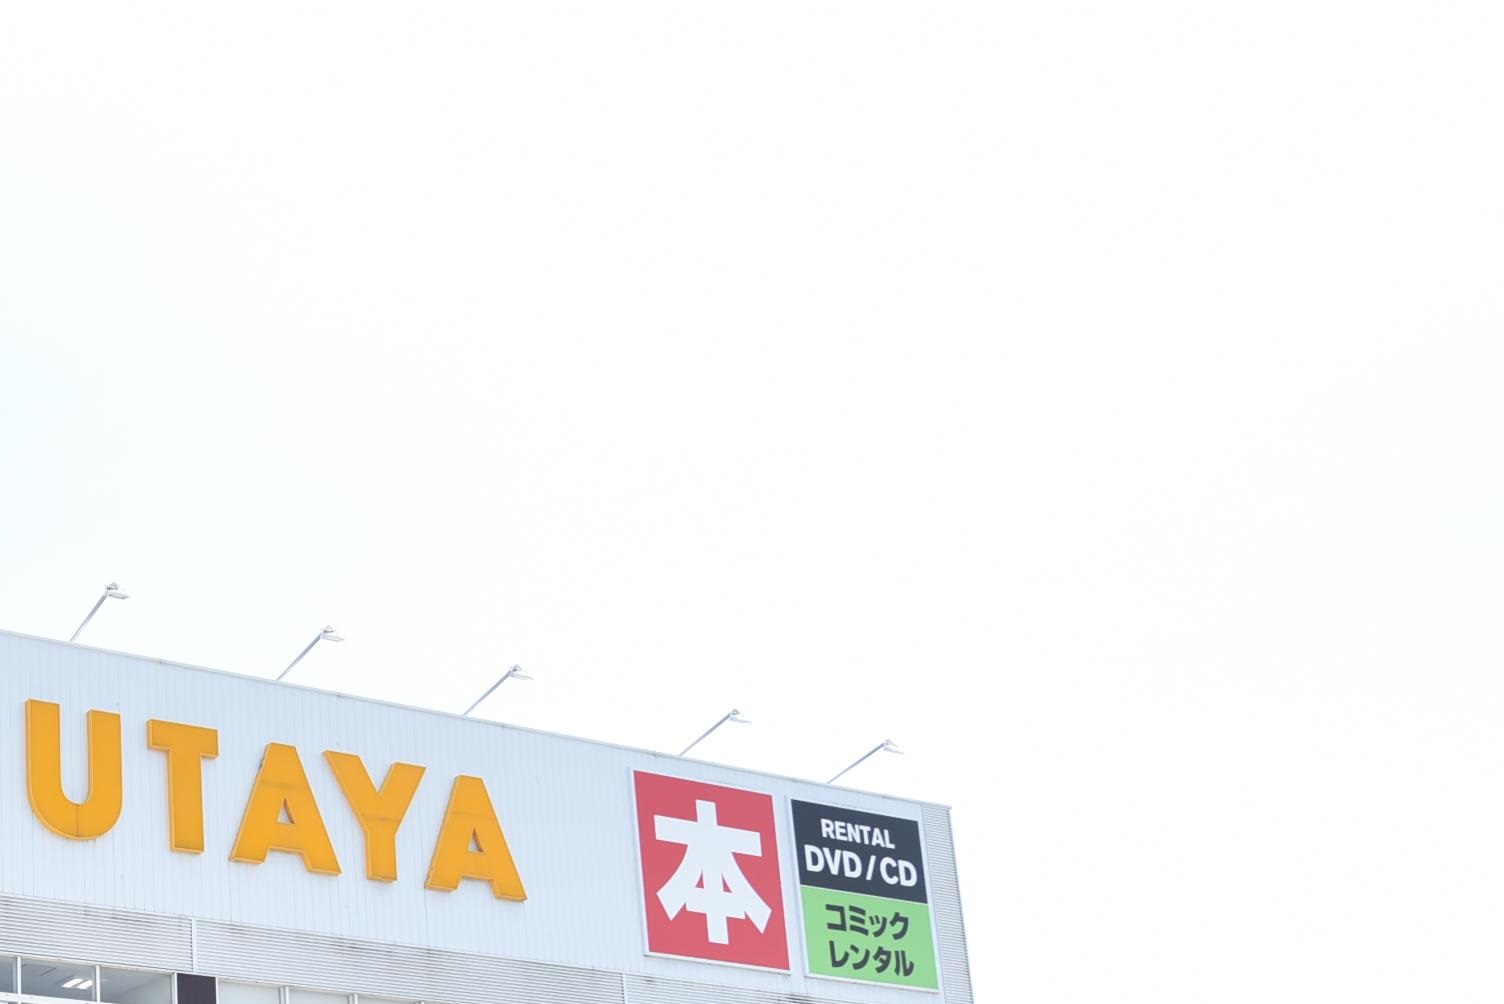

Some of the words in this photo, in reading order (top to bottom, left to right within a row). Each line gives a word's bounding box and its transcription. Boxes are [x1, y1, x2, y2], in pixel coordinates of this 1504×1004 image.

[820, 817, 896, 850] RENTAL
[652, 798, 773, 946] 本
[824, 903, 910, 940] コミック
[828, 940, 915, 977] レンタル
